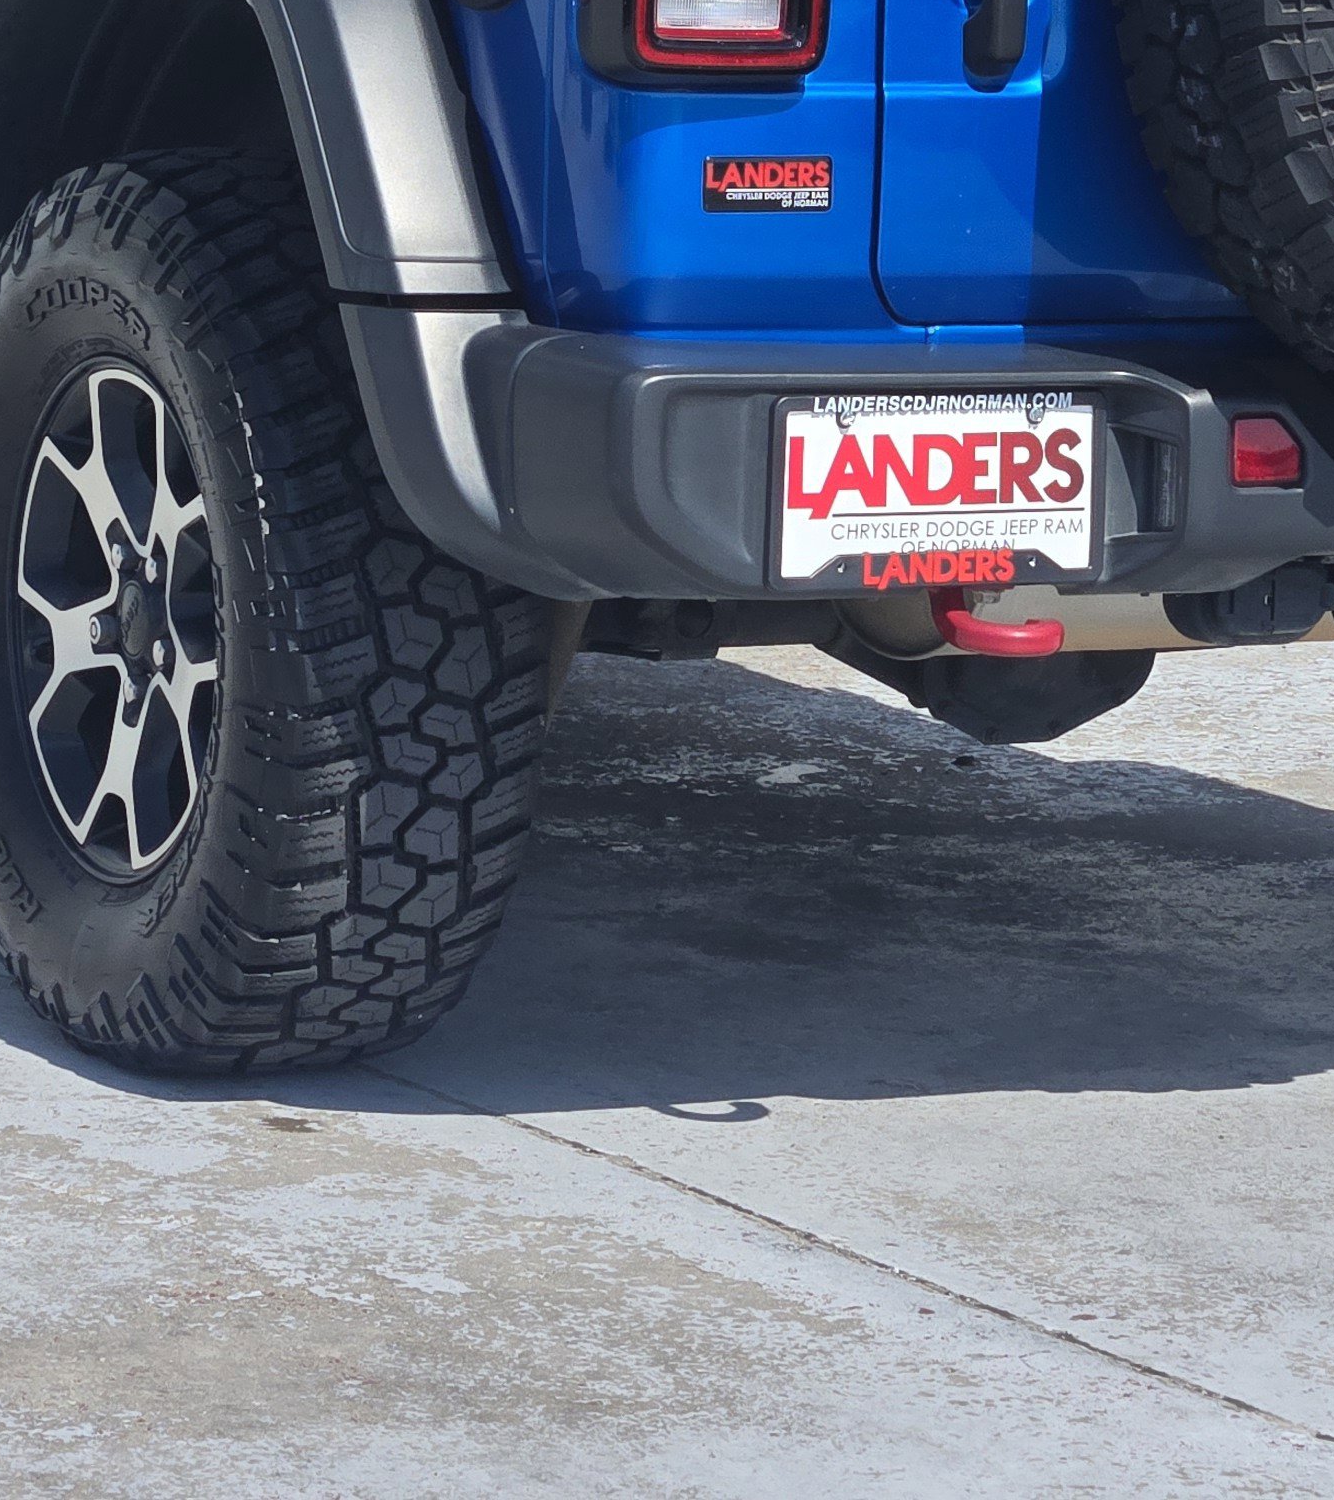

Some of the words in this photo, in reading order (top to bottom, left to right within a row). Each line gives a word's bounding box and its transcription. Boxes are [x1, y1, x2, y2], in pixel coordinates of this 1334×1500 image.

[706, 161, 830, 192] LANDERS
[764, 192, 792, 200] DODGE
[26, 276, 152, 351] COOPER
[813, 392, 1073, 412] LANDERSCDJRNORMAN.COM
[787, 428, 1084, 520] LANDERS
[831, 522, 920, 540] CHRYSLER
[926, 520, 995, 538] DODGE
[1000, 519, 1039, 536] JEEP
[1044, 518, 1084, 534] RAM
[862, 550, 1015, 590] LANDERS
